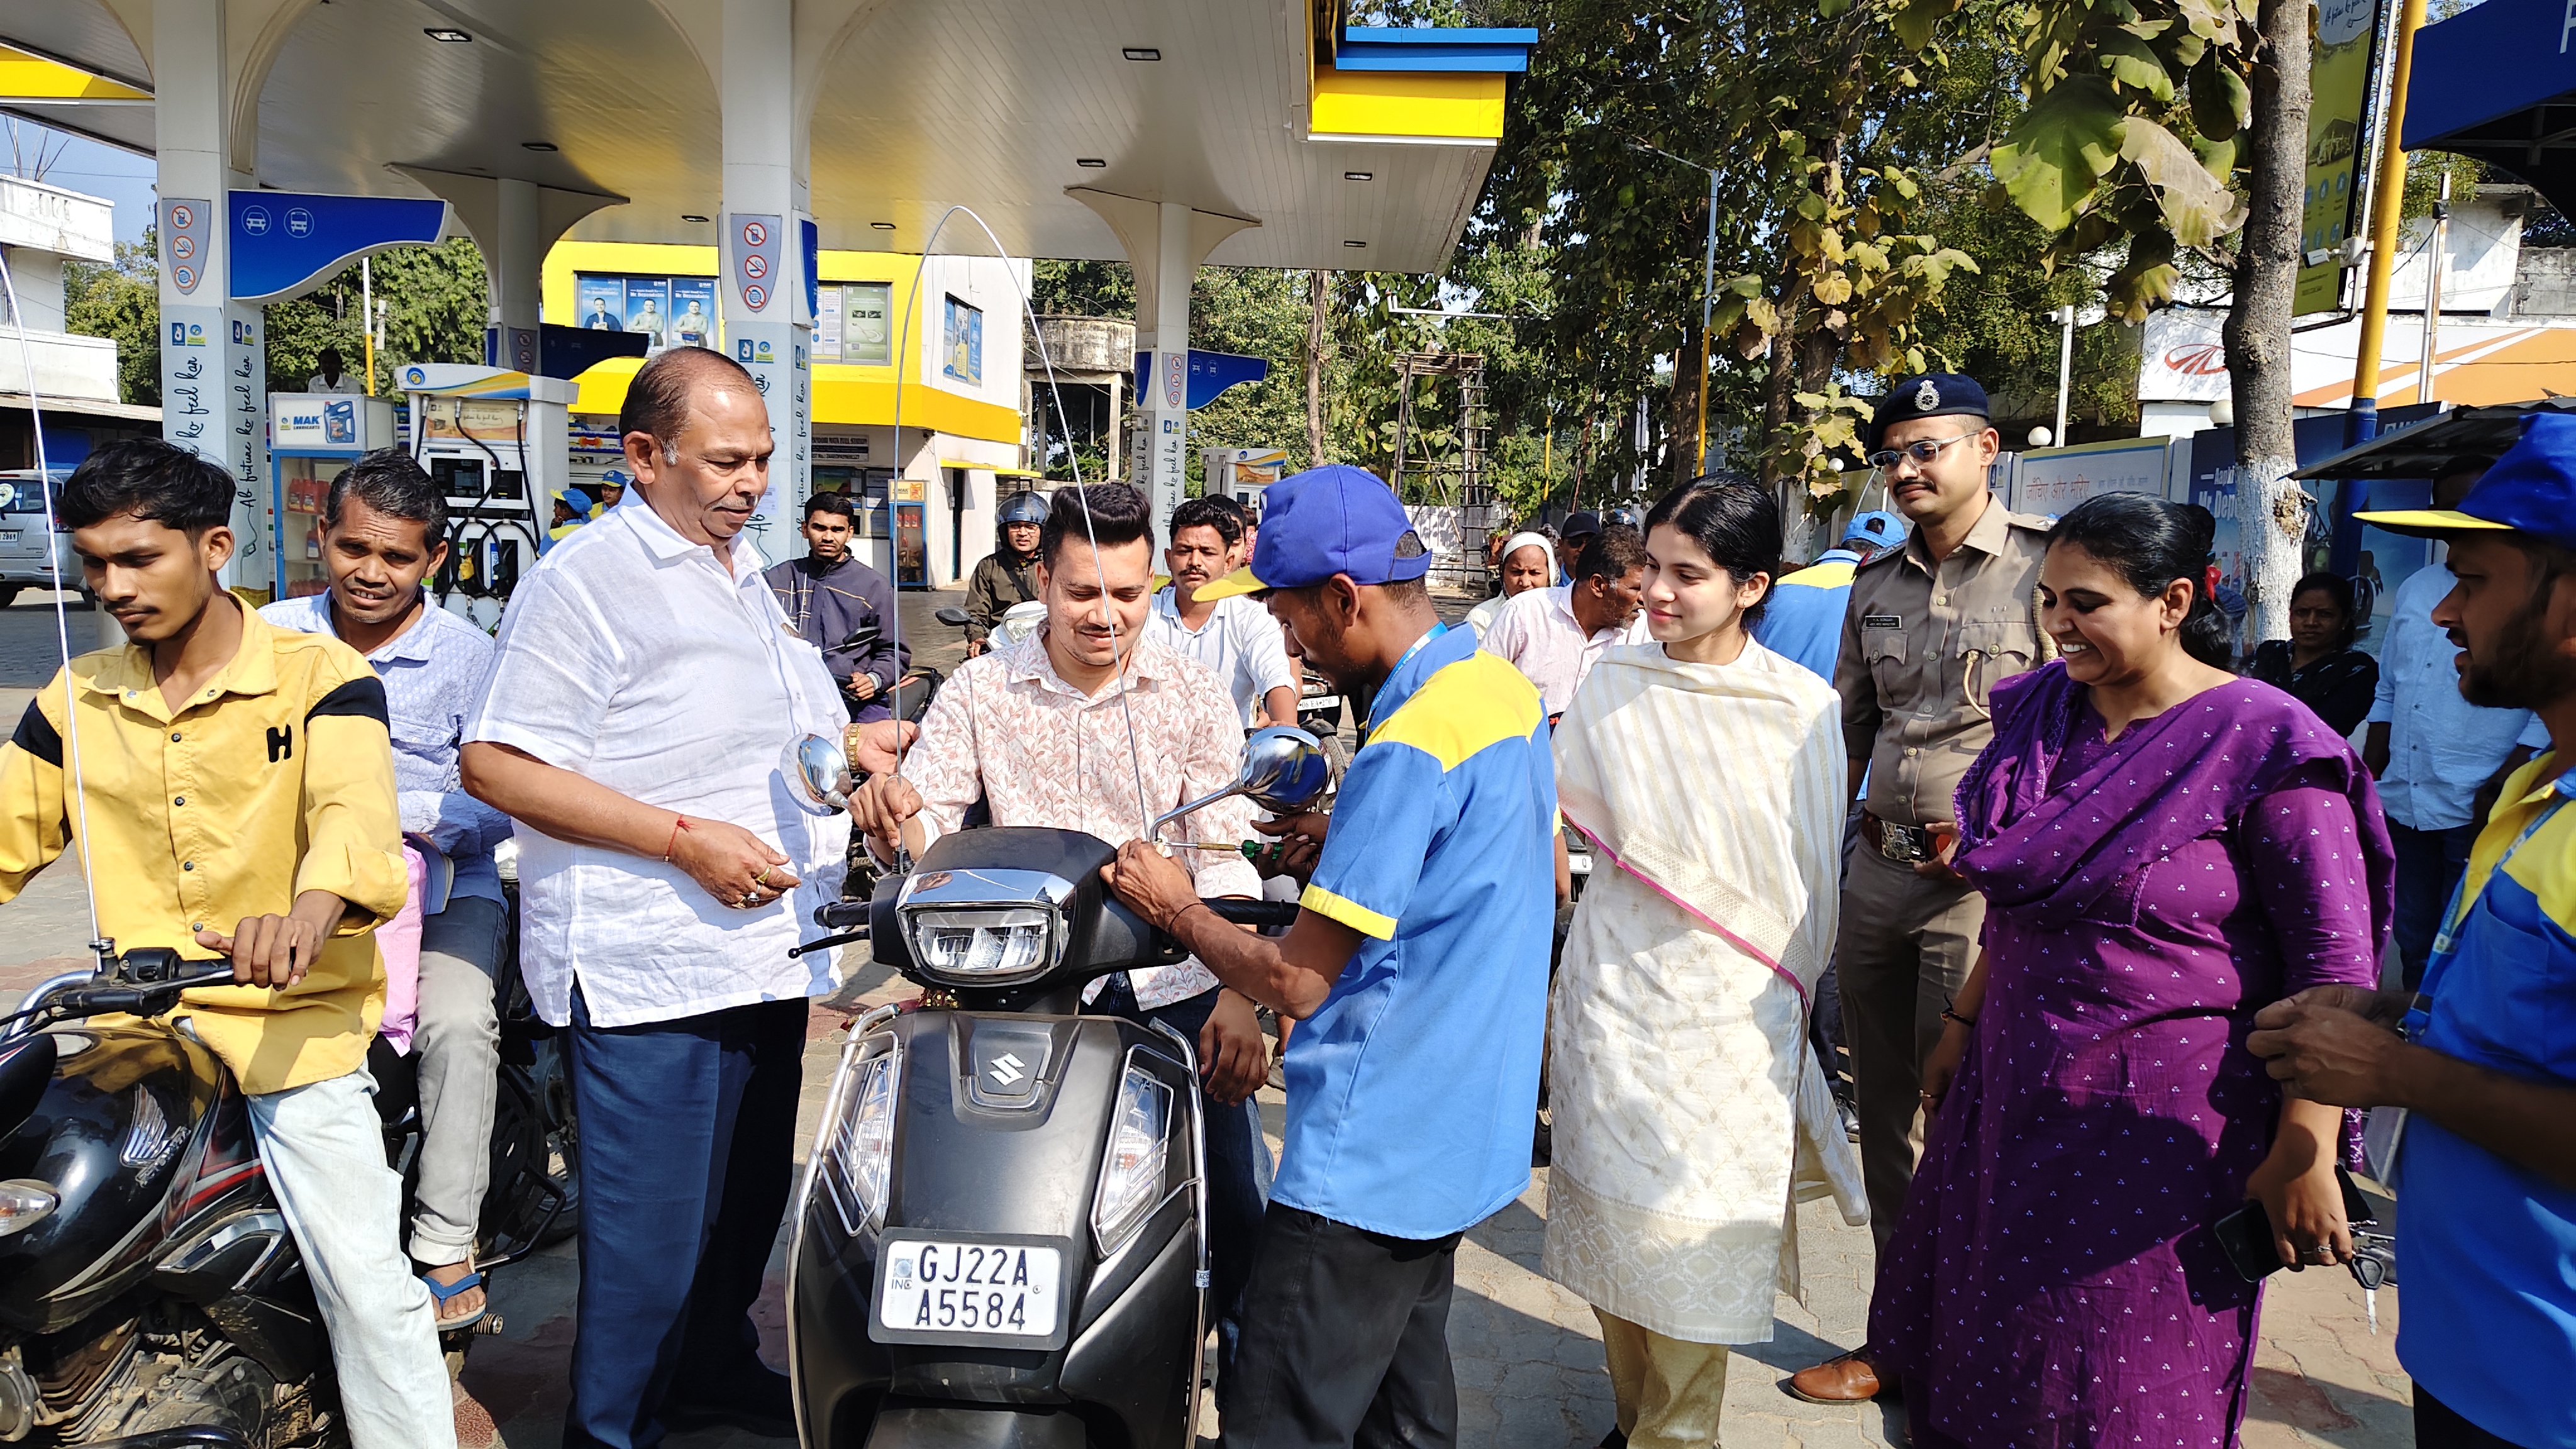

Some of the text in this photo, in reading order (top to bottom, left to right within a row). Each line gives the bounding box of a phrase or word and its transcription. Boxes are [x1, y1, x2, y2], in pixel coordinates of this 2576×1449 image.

[174, 386, 209, 414] feel
[293, 416, 320, 425] MAK
[267, 724, 292, 763] H
[919, 1245, 1029, 1287] GJ22A
[914, 1288, 1026, 1331] A5584
